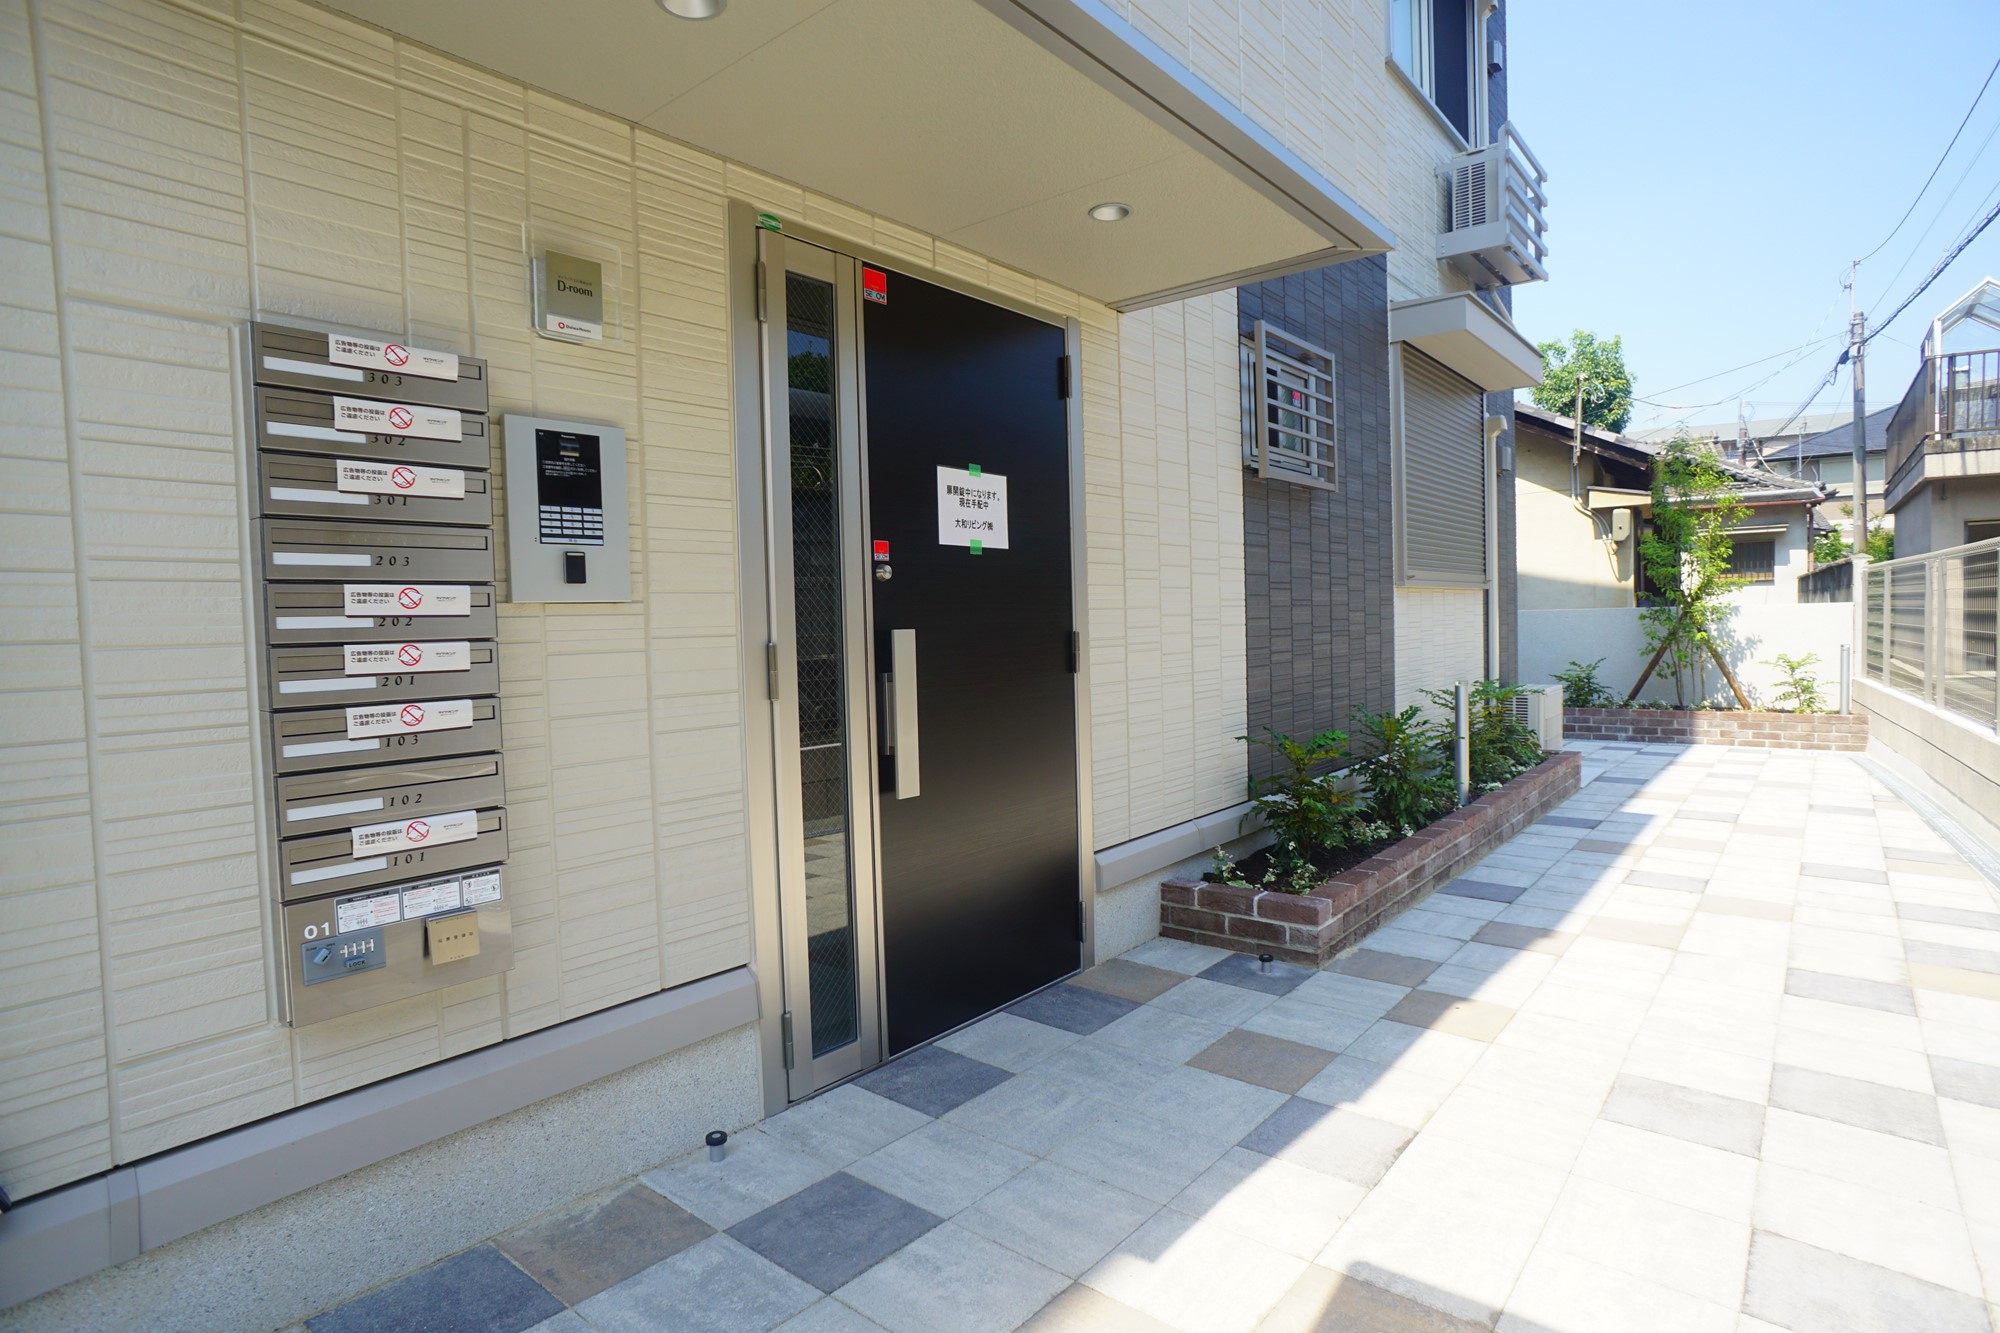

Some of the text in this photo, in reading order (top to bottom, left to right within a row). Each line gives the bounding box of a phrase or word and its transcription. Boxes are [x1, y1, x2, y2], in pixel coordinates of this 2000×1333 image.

[557, 279, 593, 297] D-room
[865, 289, 886, 301] SECOM
[335, 346, 375, 357] ご遠慮ください
[367, 372, 403, 386] 303
[341, 412, 380, 421] ご遠慮ください
[371, 435, 406, 446] 302
[374, 495, 409, 506] 301
[959, 497, 989, 510] 現在手配中
[375, 555, 410, 566] 203
[379, 617, 412, 626] 202
[382, 676, 415, 687] 201
[353, 717, 392, 726] ご遠慮ください
[386, 735, 419, 747] 103
[390, 793, 423, 806] 102
[359, 836, 398, 846] ご遠慮ください
[392, 852, 426, 866] 101
[349, 960, 366, 968] LOCK
